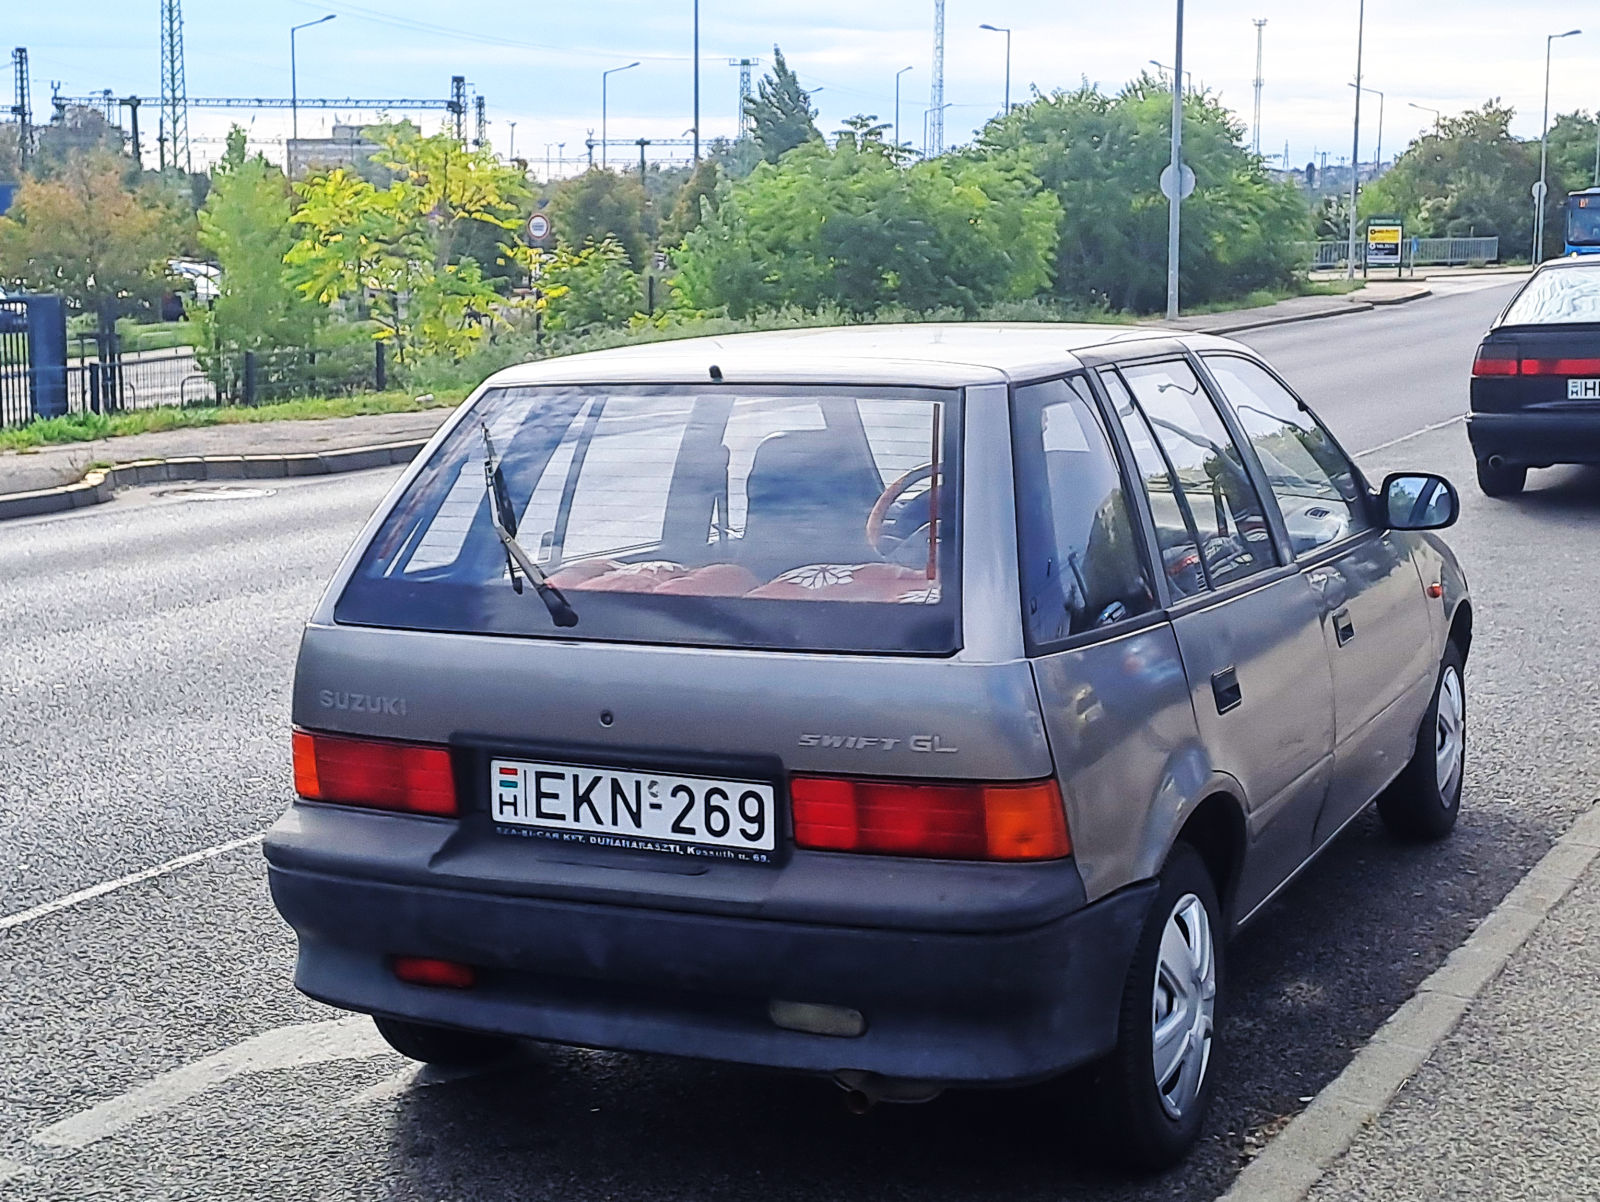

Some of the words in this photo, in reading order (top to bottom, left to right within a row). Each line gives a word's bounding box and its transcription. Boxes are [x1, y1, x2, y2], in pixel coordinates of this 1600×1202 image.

[1585, 381, 1600, 396] H
[320, 689, 406, 716] SUZUKI
[799, 734, 900, 750] SWIFT
[910, 735, 958, 752] GL
[499, 793, 518, 816] H
[534, 770, 765, 842] EKN-269
